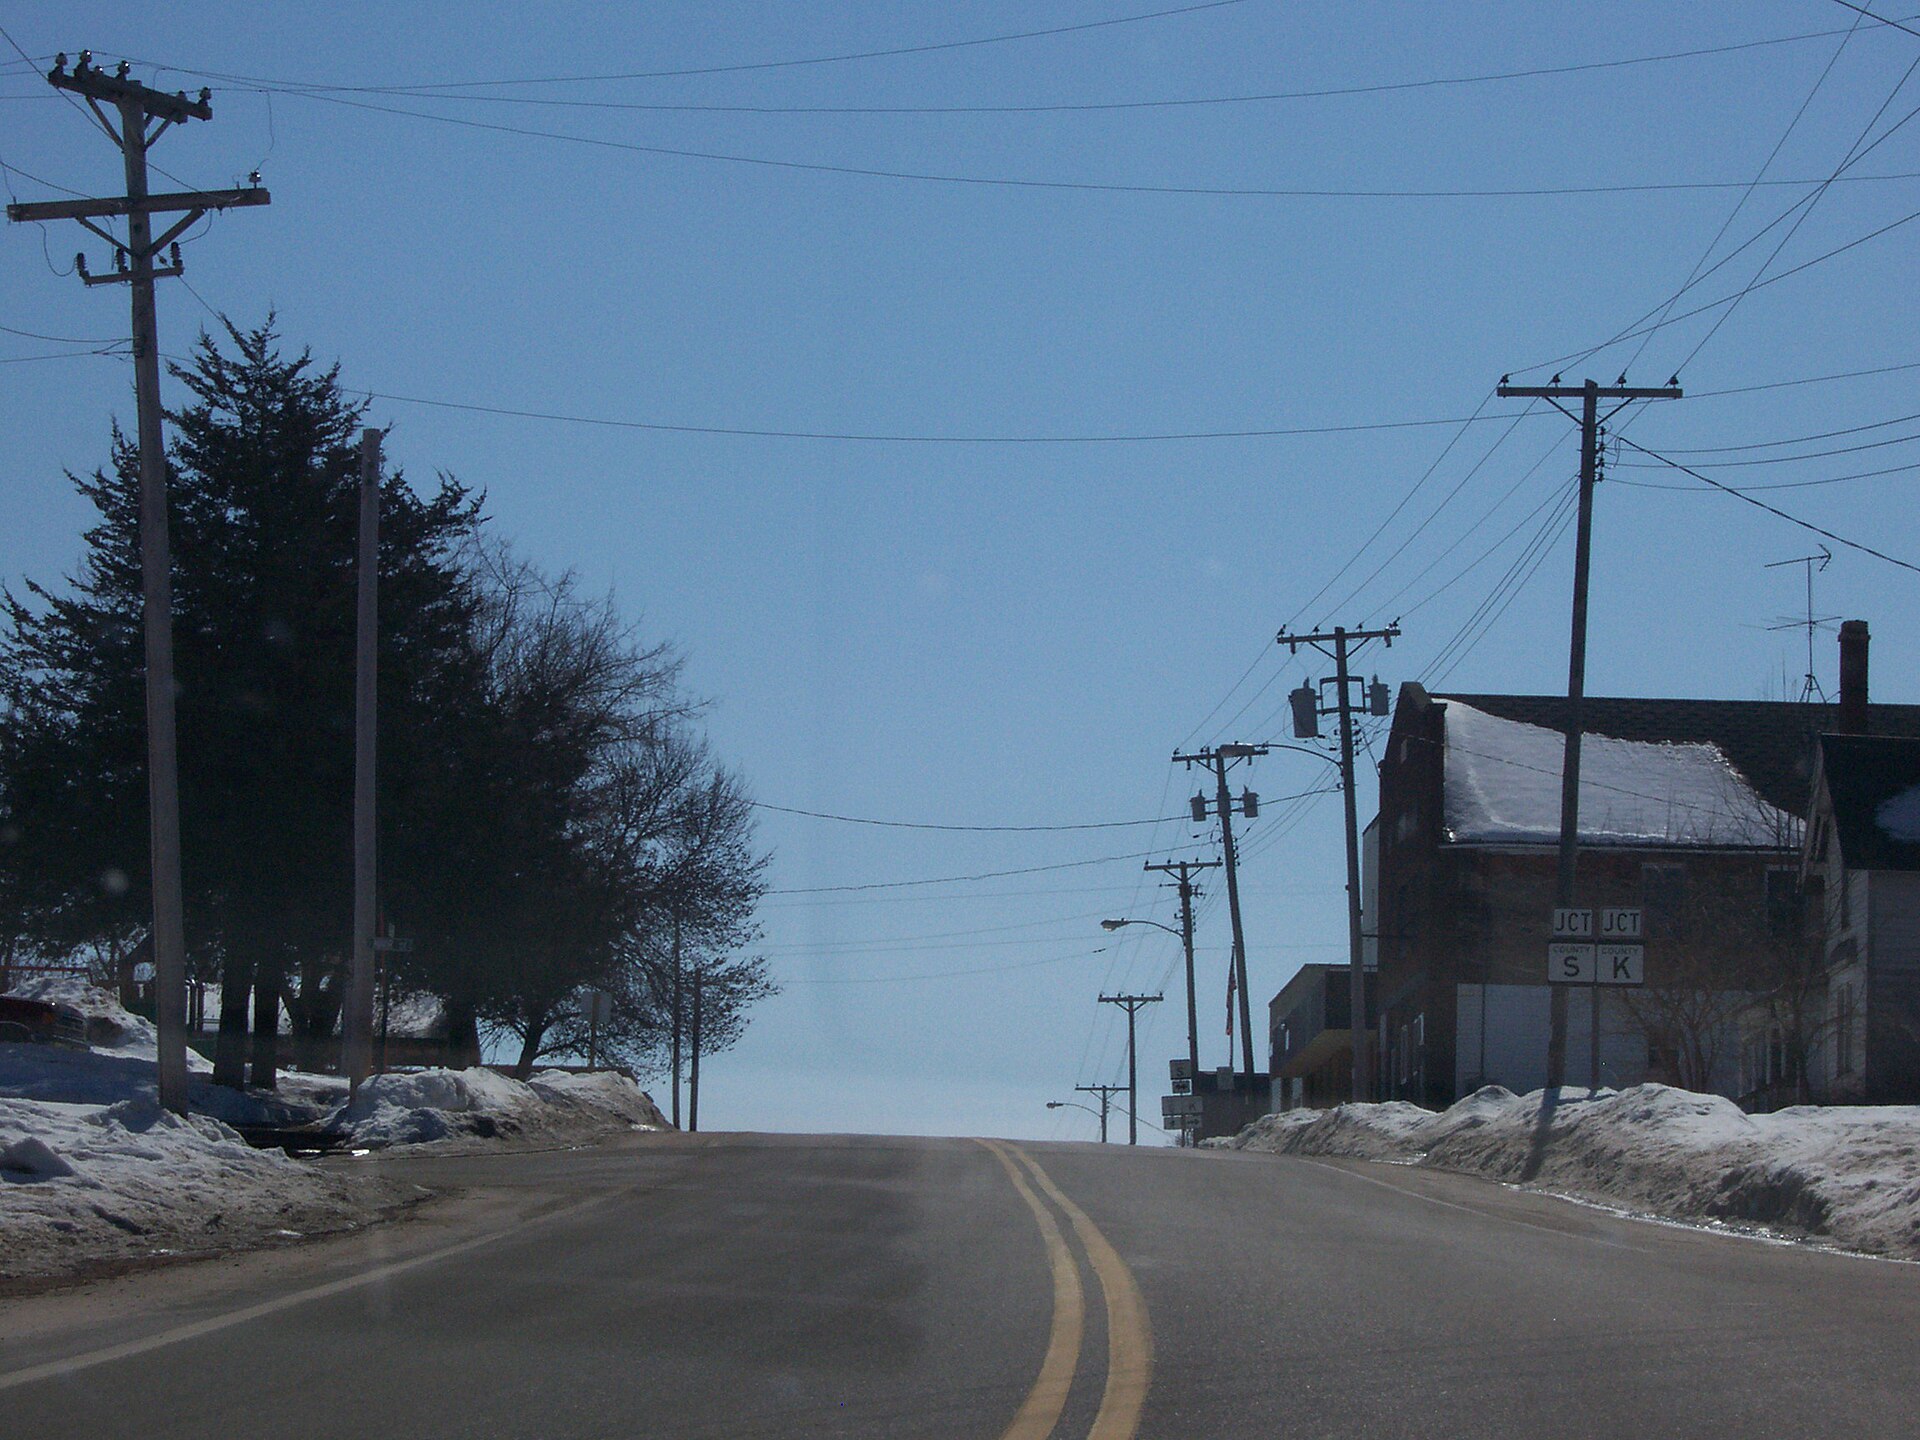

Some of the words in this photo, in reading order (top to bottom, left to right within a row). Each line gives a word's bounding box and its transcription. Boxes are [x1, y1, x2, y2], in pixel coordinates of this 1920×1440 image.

[1555, 912, 1591, 932] JCT
[1603, 912, 1640, 932] JCT
[1552, 945, 1591, 954] COUNTY
[1601, 946, 1639, 955] COUNTY
[1564, 956, 1580, 977] S
[1613, 956, 1631, 979] K
